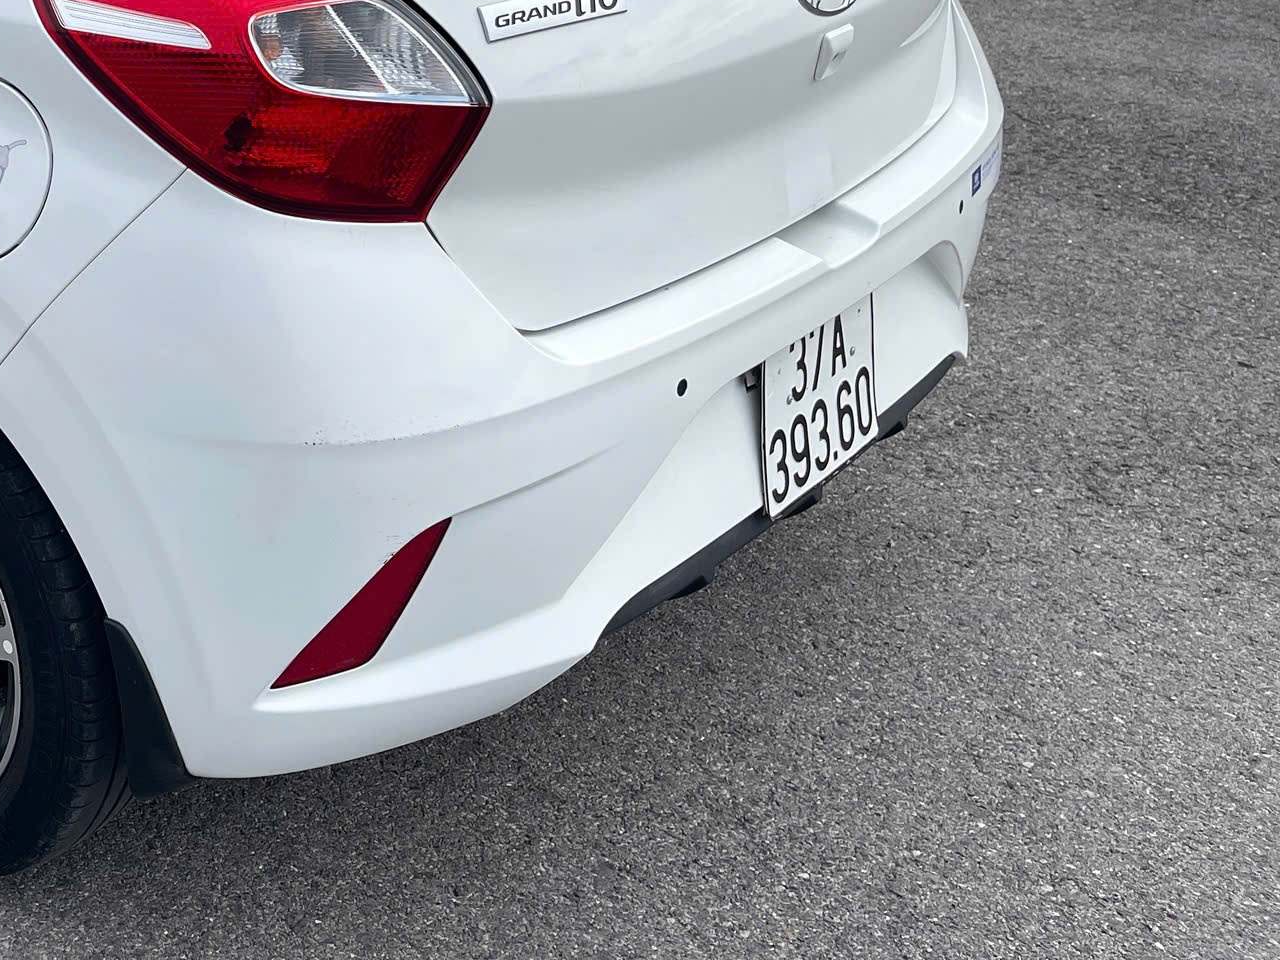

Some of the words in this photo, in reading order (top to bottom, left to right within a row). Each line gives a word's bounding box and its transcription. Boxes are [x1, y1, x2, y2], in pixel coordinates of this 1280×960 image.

[495, 0, 572, 28] GRAND
[789, 313, 847, 402] 37A
[769, 366, 873, 503] 393.60
